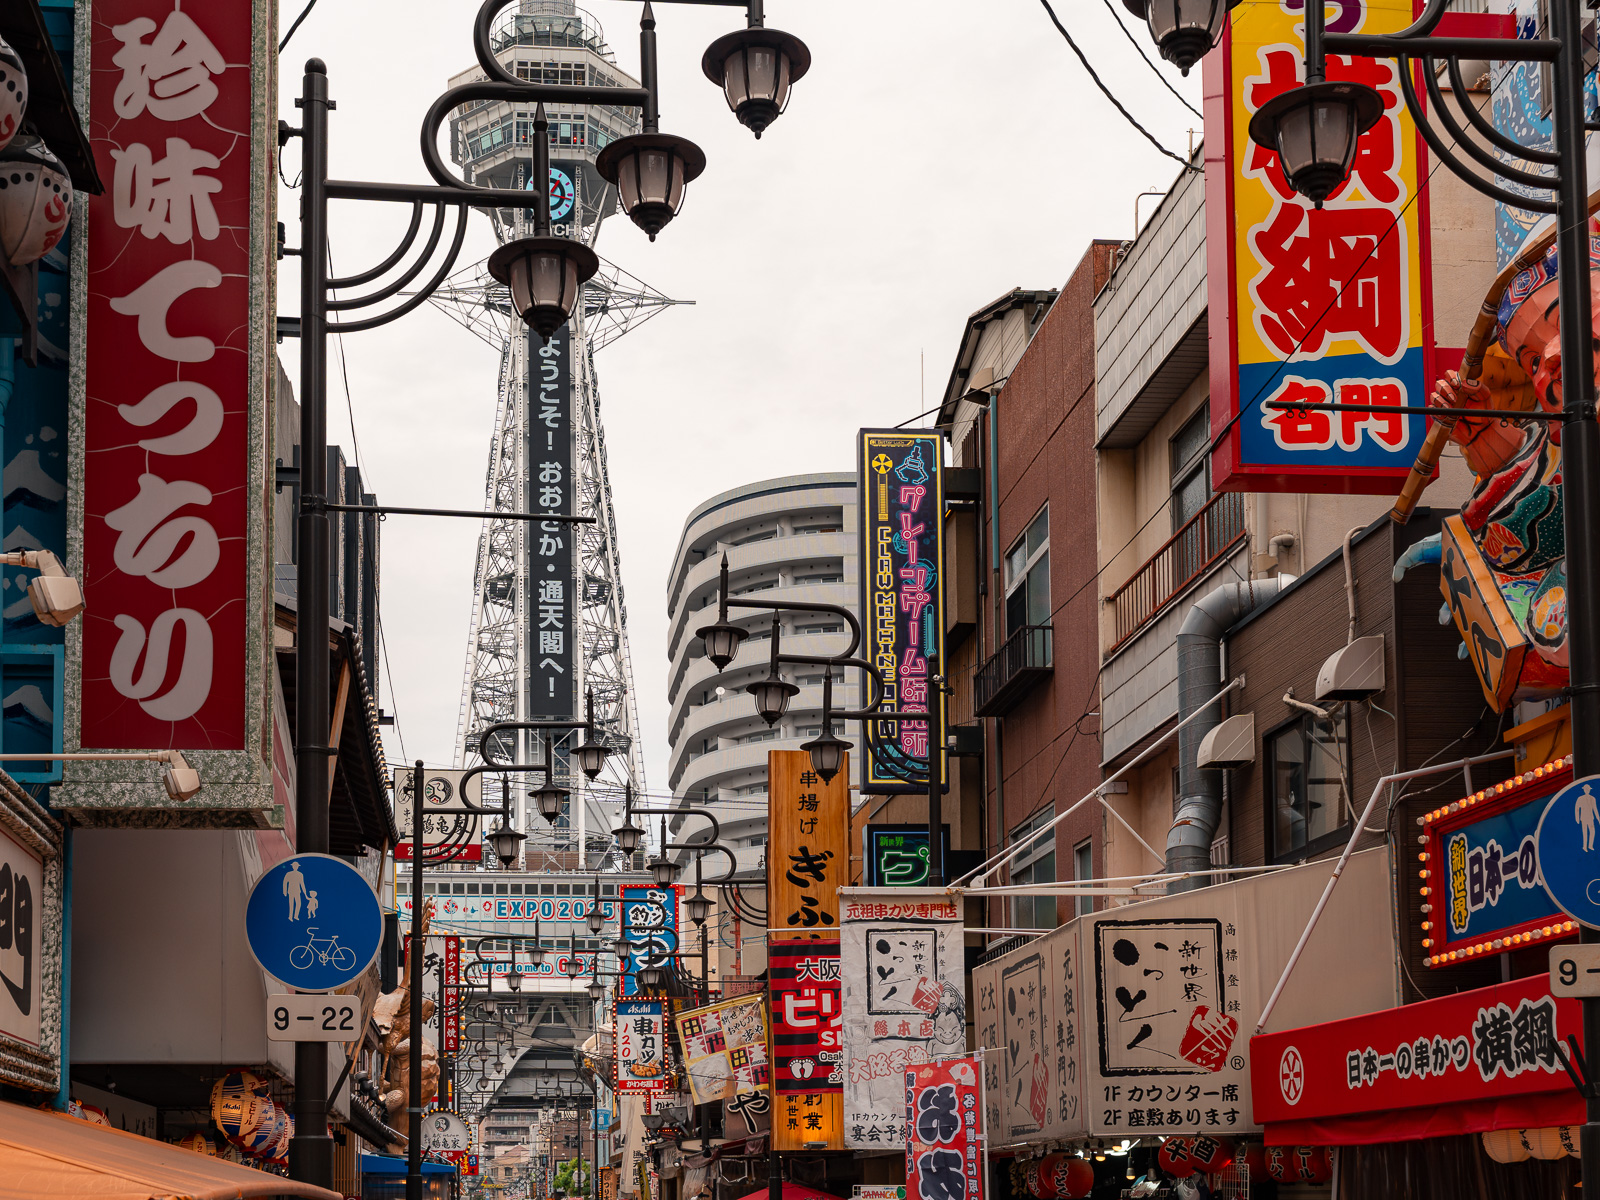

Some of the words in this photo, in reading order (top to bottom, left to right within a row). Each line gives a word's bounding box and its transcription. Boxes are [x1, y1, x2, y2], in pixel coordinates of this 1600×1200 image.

[1268, 380, 1404, 446] 名門
[877, 526, 893, 590] CLAW
[875, 591, 897, 681] MACHINE
[797, 770, 820, 835] 串揚げ
[785, 846, 835, 940] ぎふ
[846, 903, 958, 919] 元祖串カツ専門店
[1451, 840, 1467, 928] 新世界
[633, 1016, 655, 1063] 串カツ
[1104, 1085, 1121, 1102] 1F
[1127, 1084, 1239, 1102] カウンター席
[1104, 1109, 1122, 1126] 2F
[1128, 1108, 1240, 1127] 座敷あります
